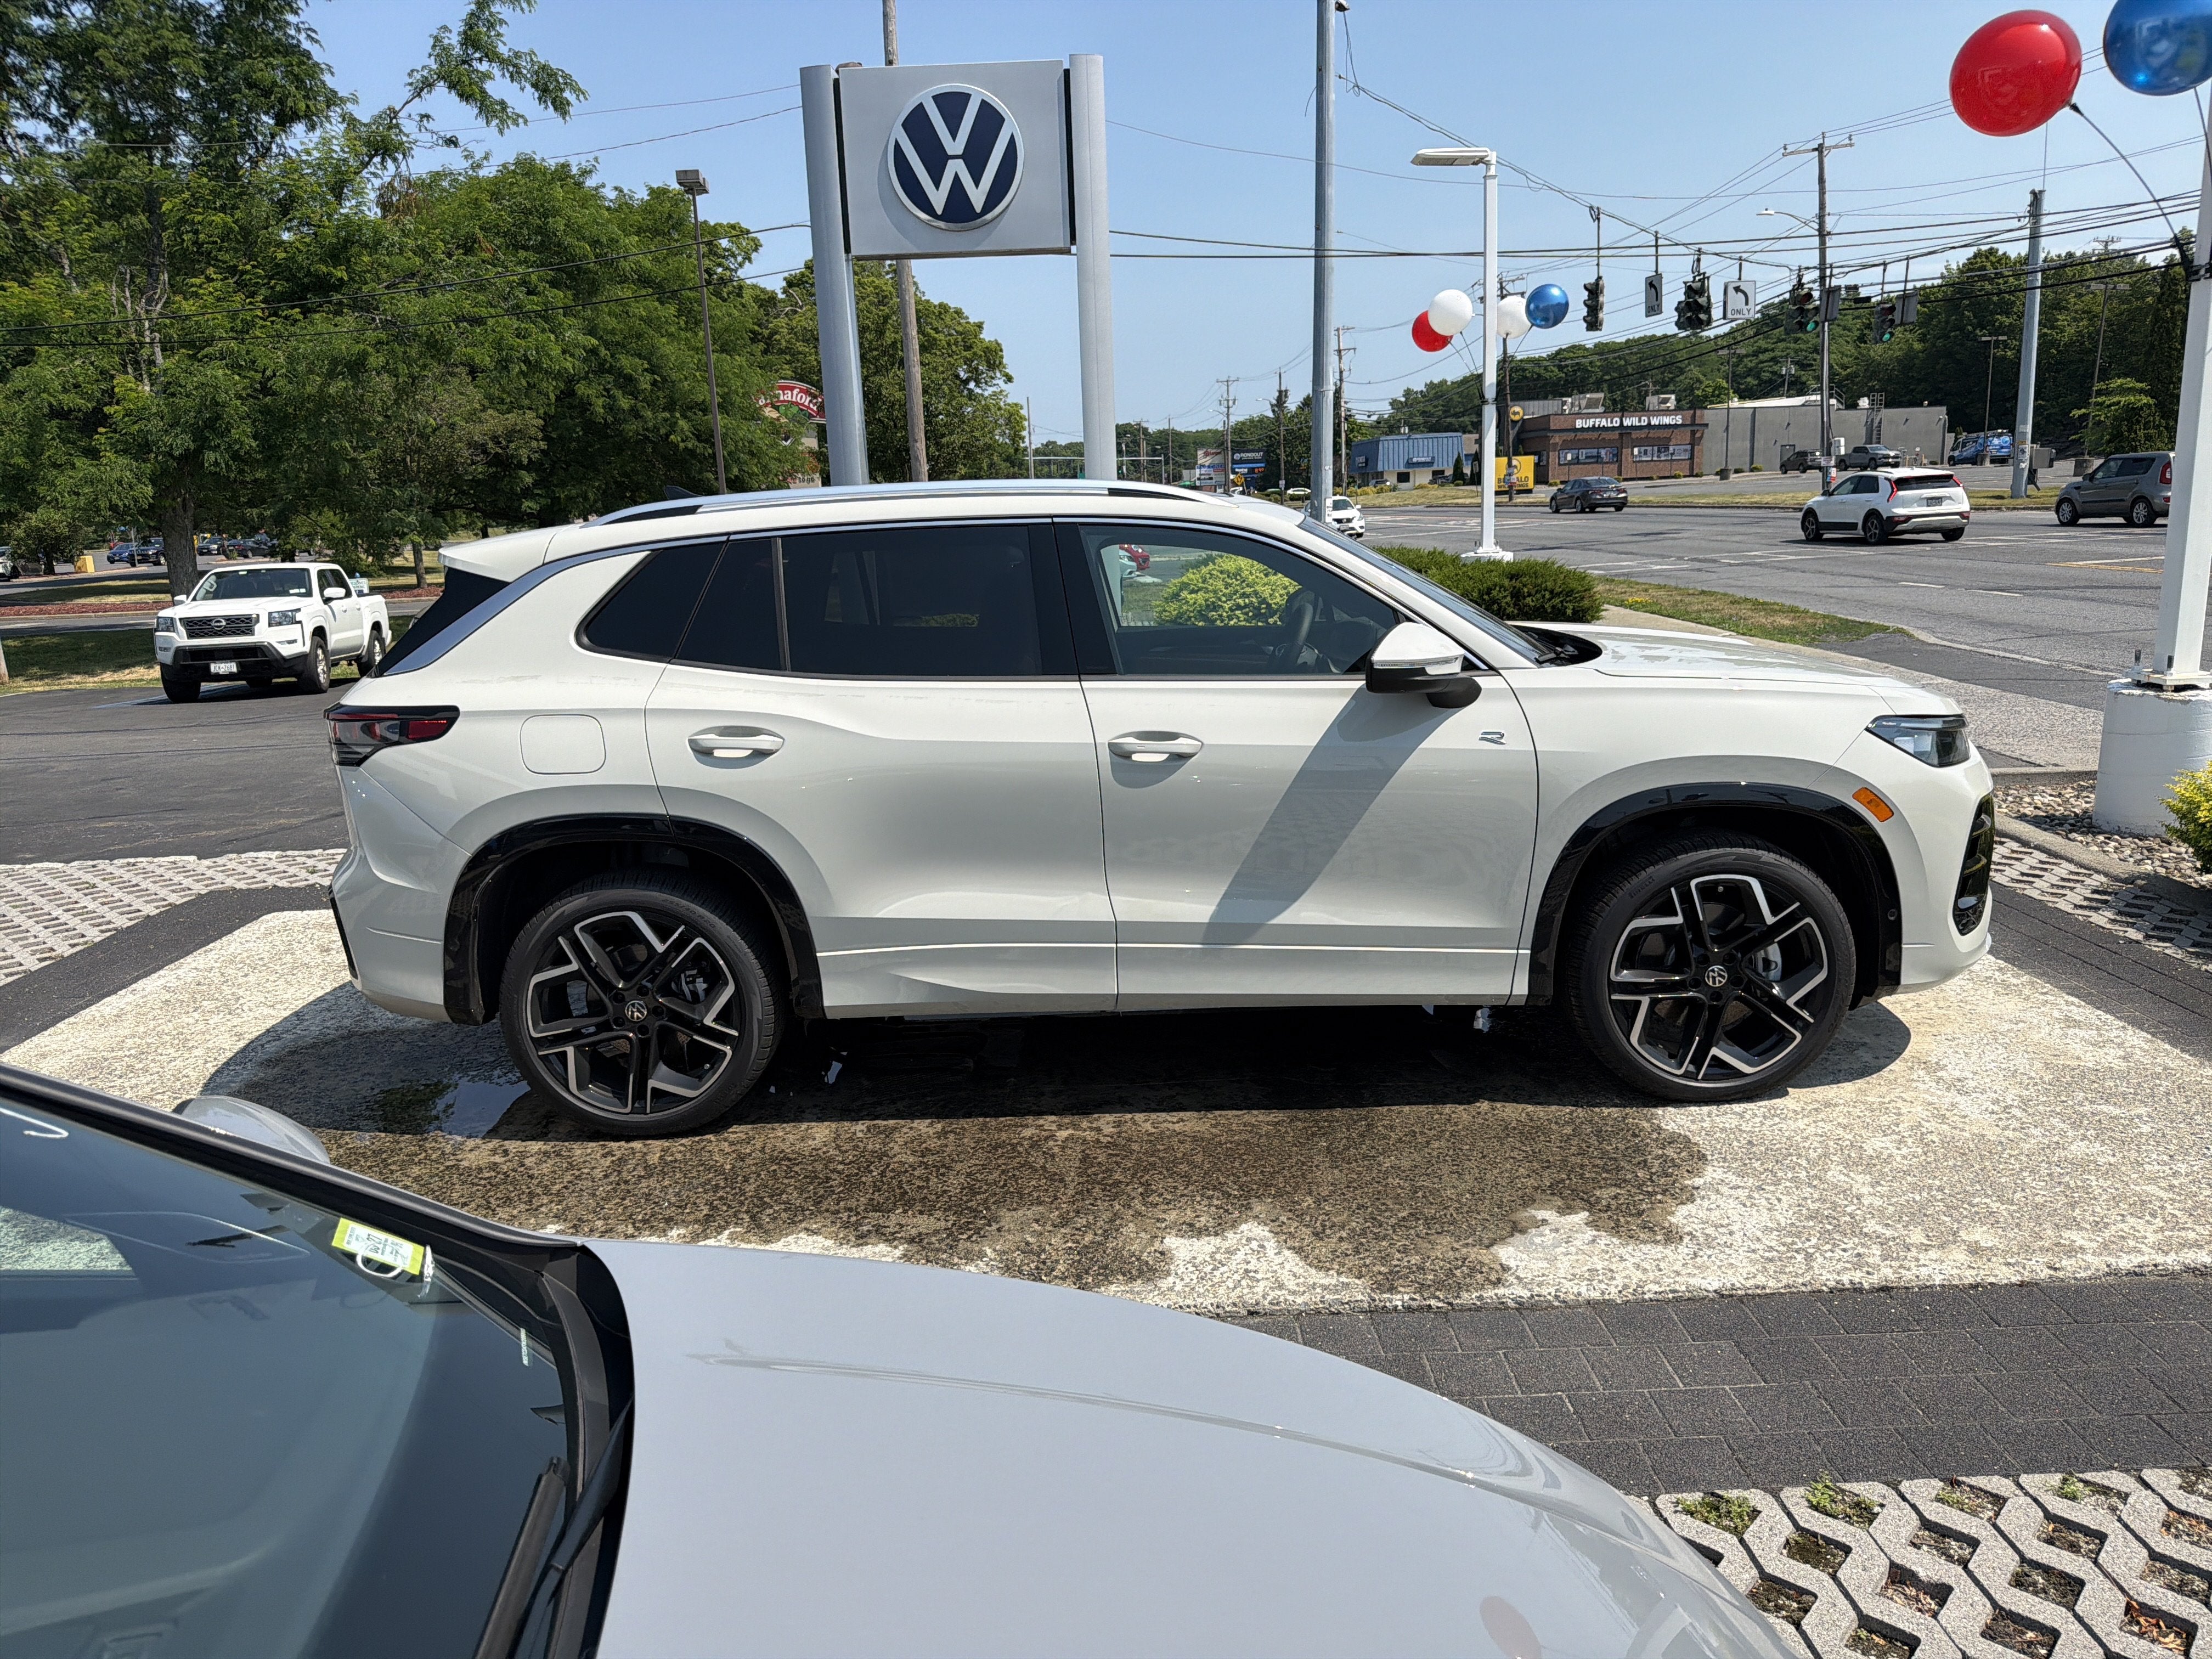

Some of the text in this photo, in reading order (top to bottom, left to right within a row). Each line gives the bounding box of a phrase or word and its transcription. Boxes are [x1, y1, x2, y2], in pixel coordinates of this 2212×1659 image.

[891, 88, 1022, 222] VW
[1647, 303, 1660, 313] ONLY
[1730, 308, 1751, 316] ONLY
[1576, 415, 1683, 428] BUFFALO WILD WINGS
[1497, 476, 1529, 484] BALO
